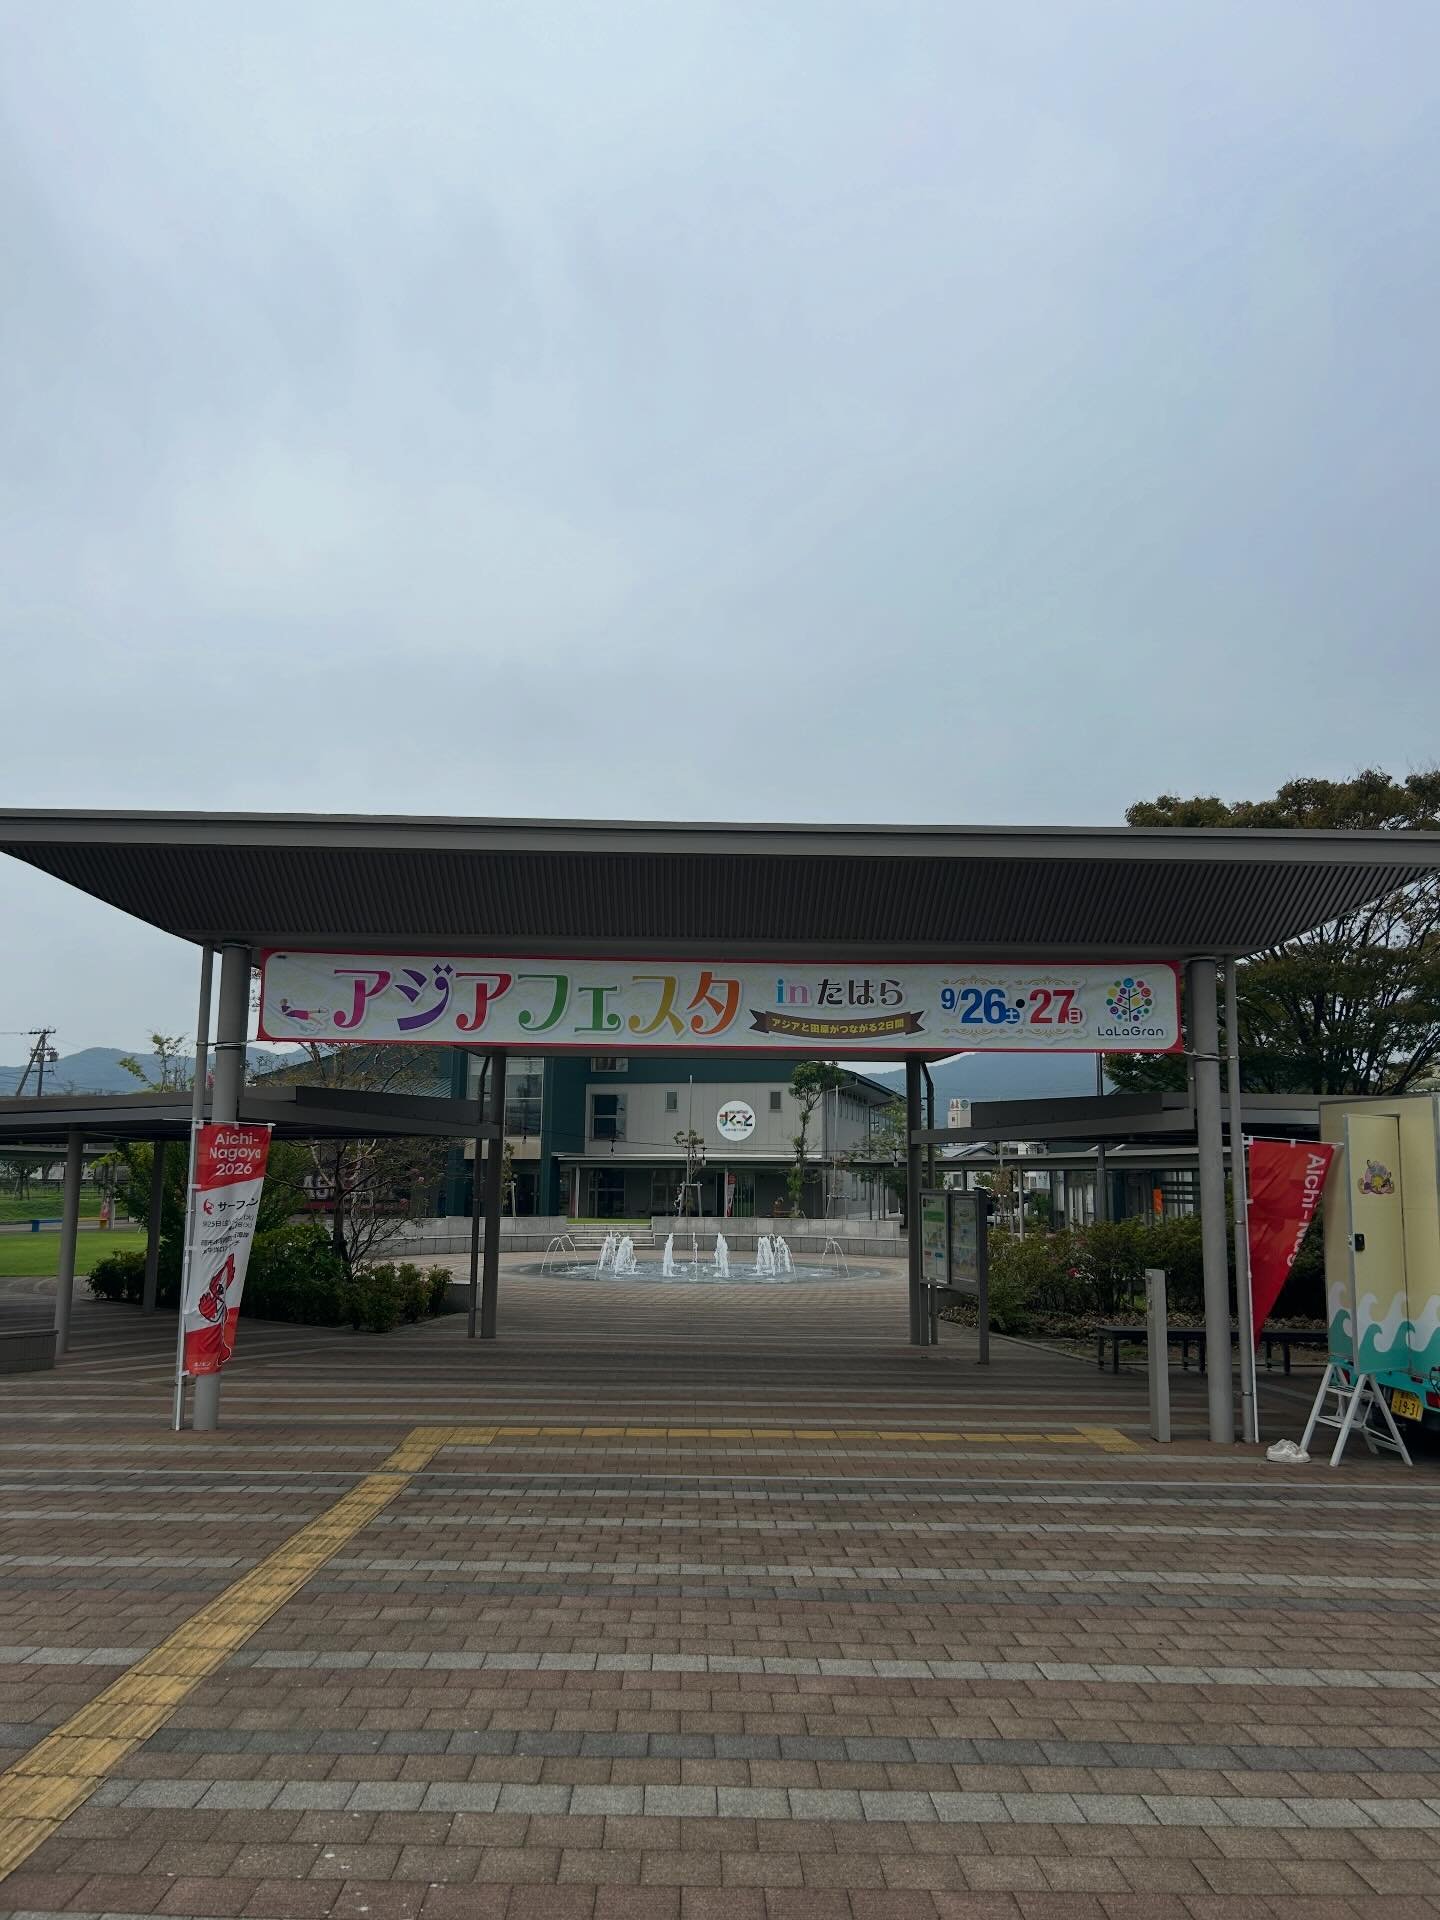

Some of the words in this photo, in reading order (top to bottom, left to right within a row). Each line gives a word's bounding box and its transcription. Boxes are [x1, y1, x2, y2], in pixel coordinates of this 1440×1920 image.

[333, 964, 741, 1036] アジアフェスタ
[775, 979, 808, 1005] in
[817, 979, 905, 1005] たはら
[771, 1018, 906, 1034] アジアと田原がつながる2日間
[1097, 1026, 1164, 1037] LaLaGran
[214, 1131, 259, 1146] Aichi-
[209, 1147, 261, 1162] Nagoya
[215, 1163, 253, 1176] 2026
